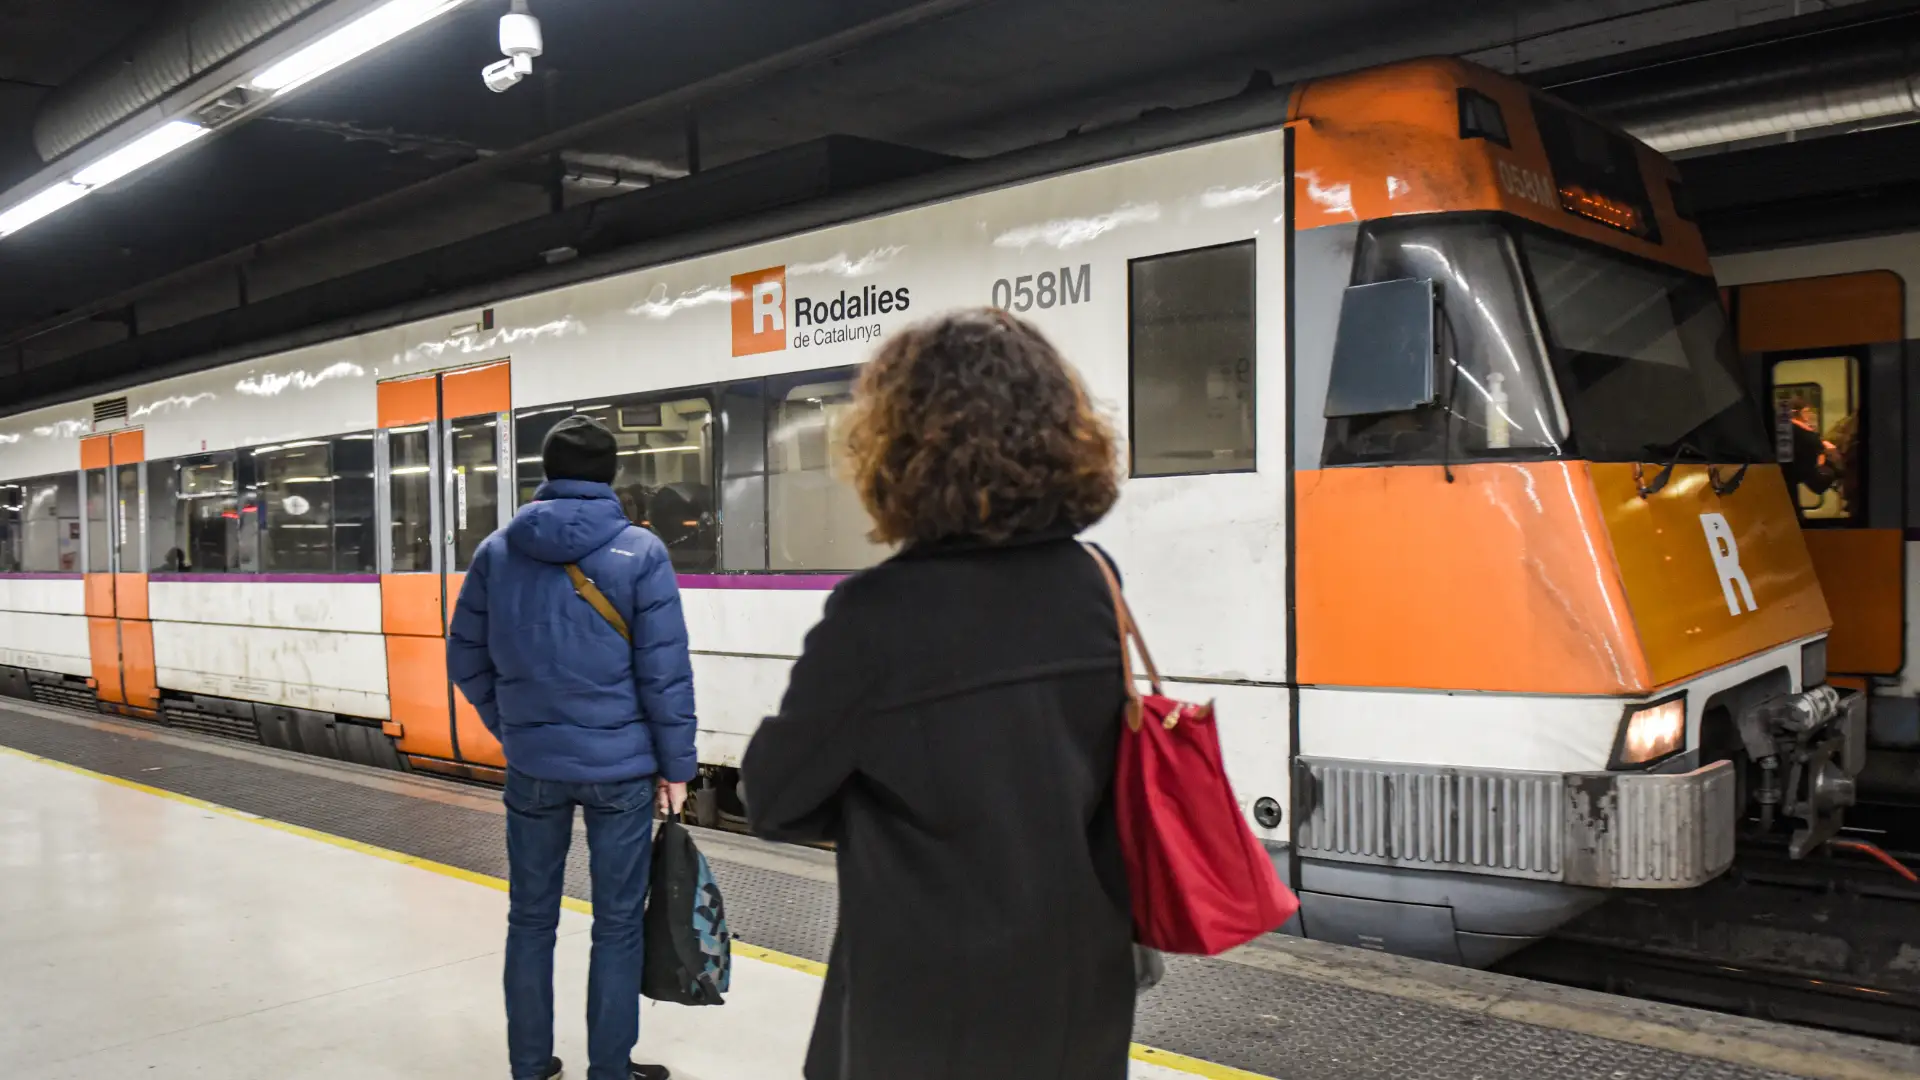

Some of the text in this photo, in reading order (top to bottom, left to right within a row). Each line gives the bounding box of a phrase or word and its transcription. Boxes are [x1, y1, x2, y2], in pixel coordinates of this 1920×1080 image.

[1498, 160, 1556, 210] 058M
[752, 281, 784, 335] R
[795, 285, 910, 327] Rodalies
[991, 263, 1091, 313] 058M
[793, 323, 882, 349] de Catalunya
[1699, 512, 1759, 617] R
